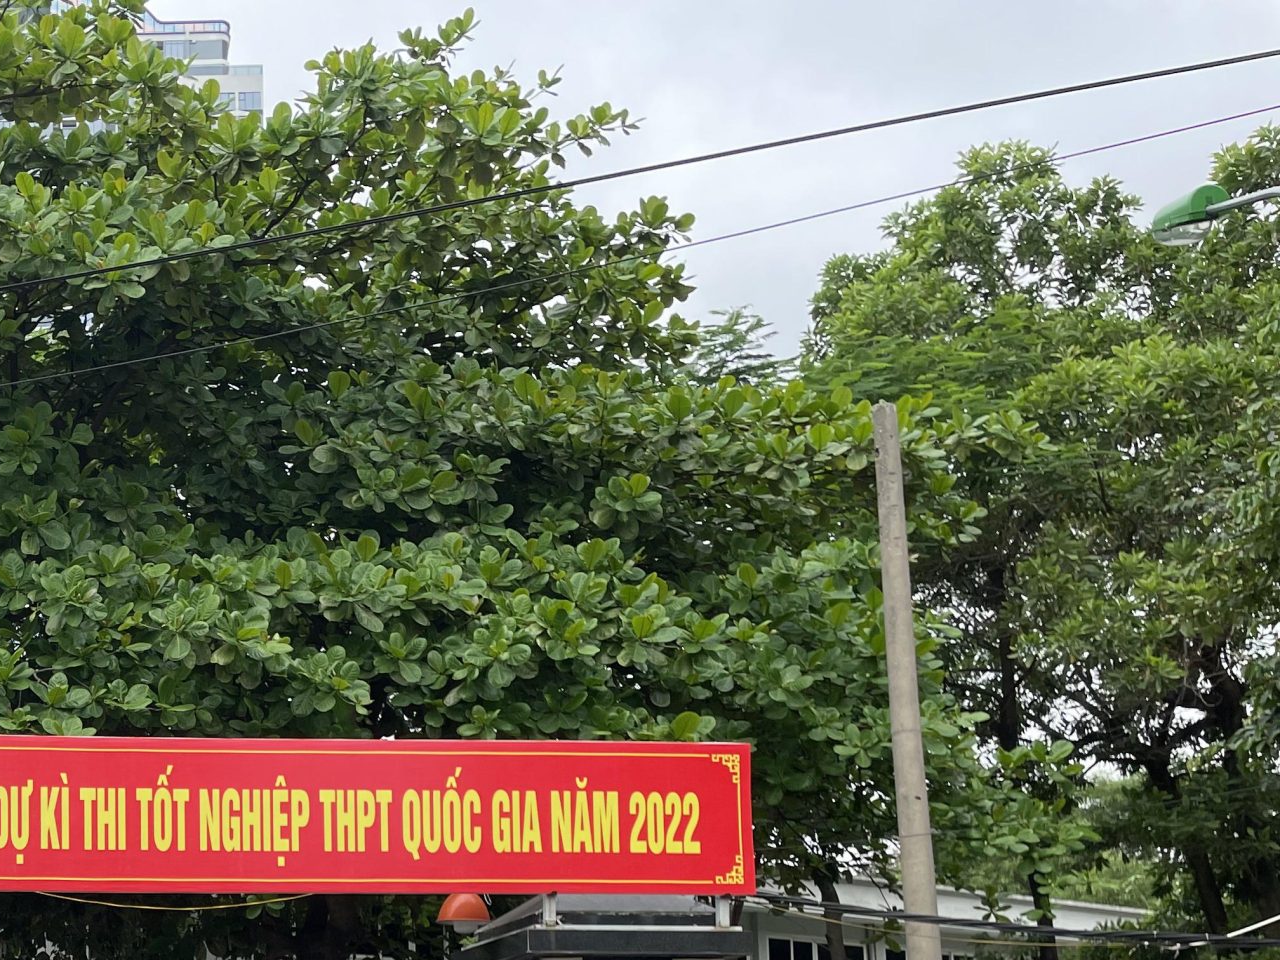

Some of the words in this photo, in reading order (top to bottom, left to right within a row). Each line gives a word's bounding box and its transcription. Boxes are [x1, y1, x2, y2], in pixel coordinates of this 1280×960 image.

[41, 773, 70, 850] KÌ
[80, 788, 126, 851] THI
[136, 765, 189, 852] TỐT
[199, 775, 310, 866] NGHIỆP
[320, 789, 392, 853] THPT
[402, 767, 482, 860] QUỐC
[492, 789, 542, 853] GIA
[551, 777, 620, 853] NĂM
[629, 791, 701, 854] 2022
